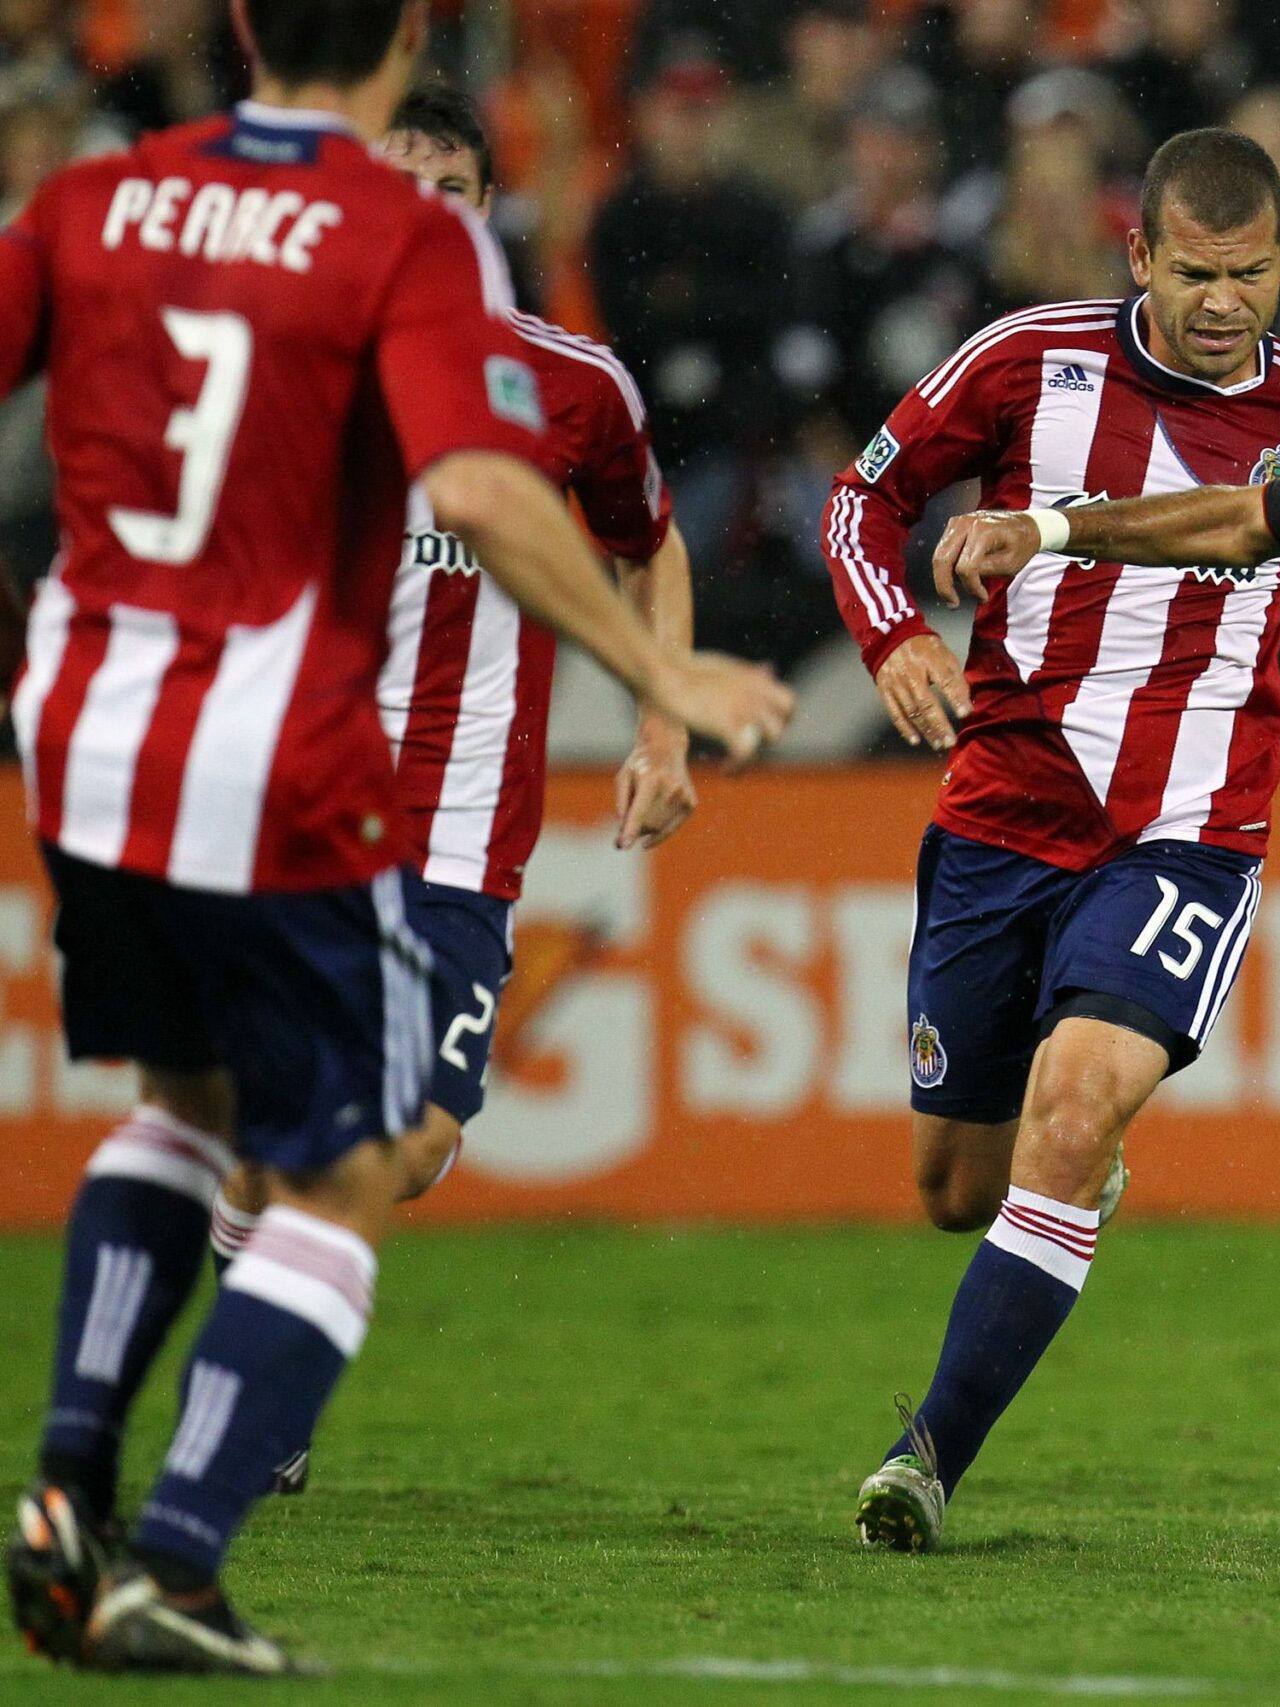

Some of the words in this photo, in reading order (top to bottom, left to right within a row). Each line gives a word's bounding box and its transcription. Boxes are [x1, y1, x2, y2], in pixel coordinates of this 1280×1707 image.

[101, 175, 344, 275] PEARCE
[105, 304, 254, 566] 3
[1048, 378, 1095, 392] adidas
[1129, 874, 1224, 981] 15
[439, 981, 495, 1072] 2
